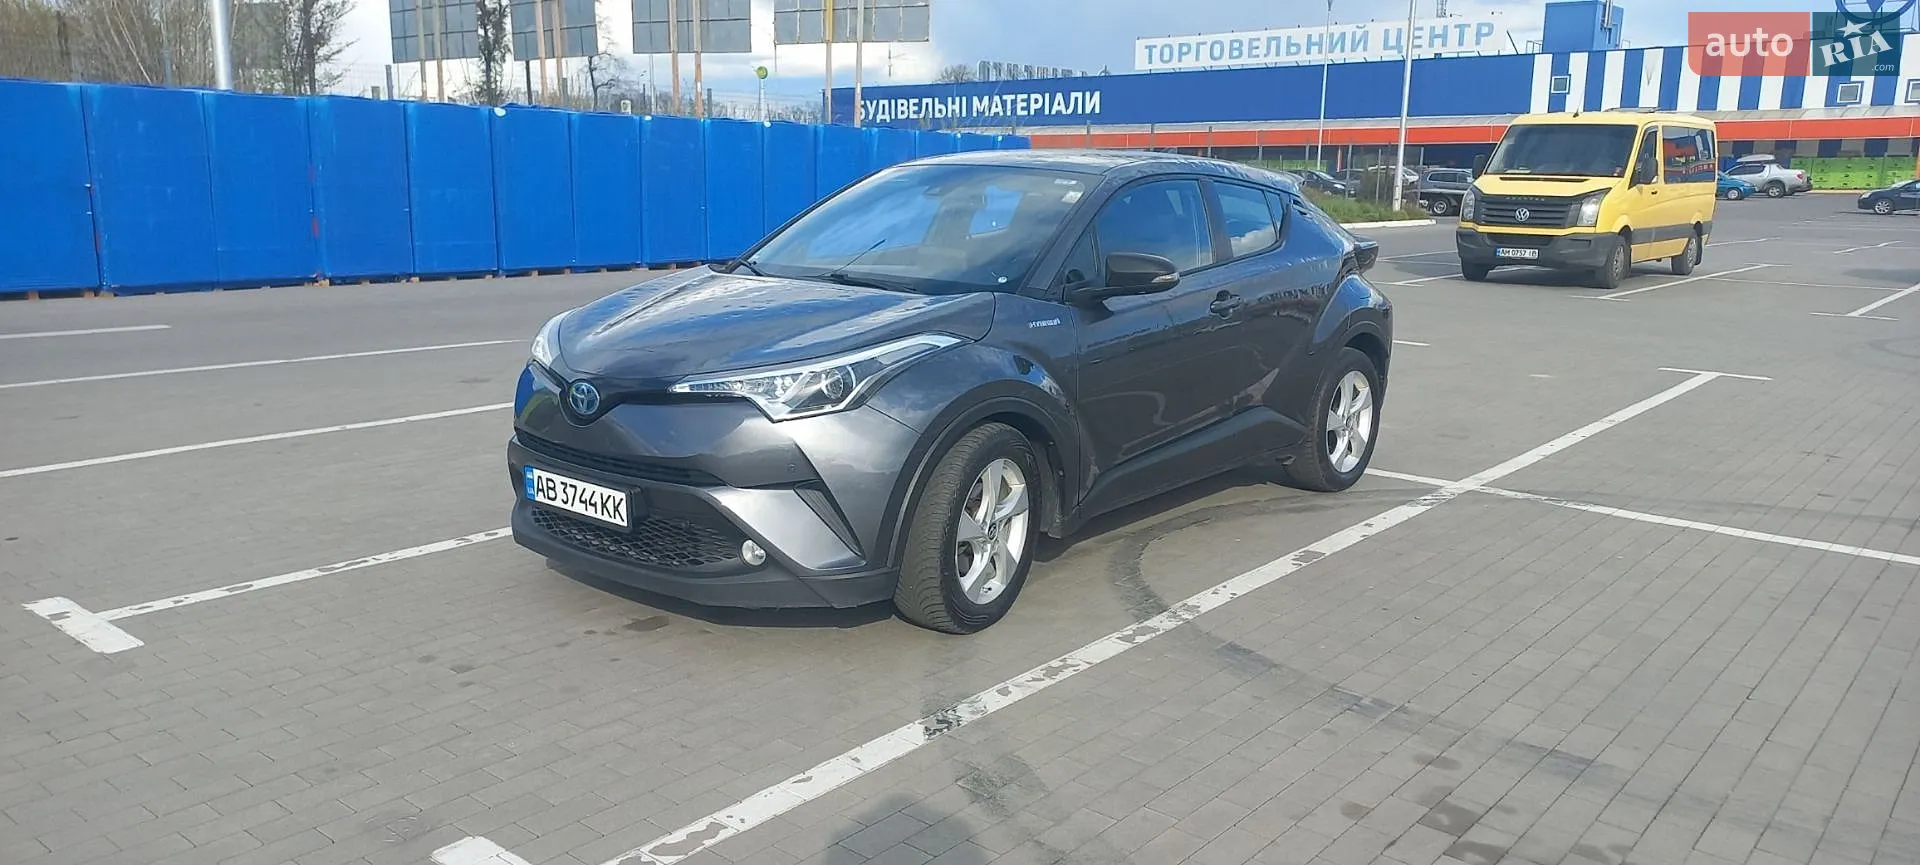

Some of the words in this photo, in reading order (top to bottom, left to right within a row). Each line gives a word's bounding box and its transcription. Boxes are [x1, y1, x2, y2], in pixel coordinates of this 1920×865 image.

[1144, 24, 1370, 65] ТОРГОВЕЛЬНИЙ
[1383, 22, 1494, 54] ЦЕНТР
[972, 91, 1101, 117] МАТЕРІАЛИ
[536, 475, 558, 502] AB
[560, 481, 598, 515] 3744
[600, 492, 625, 523] KK
